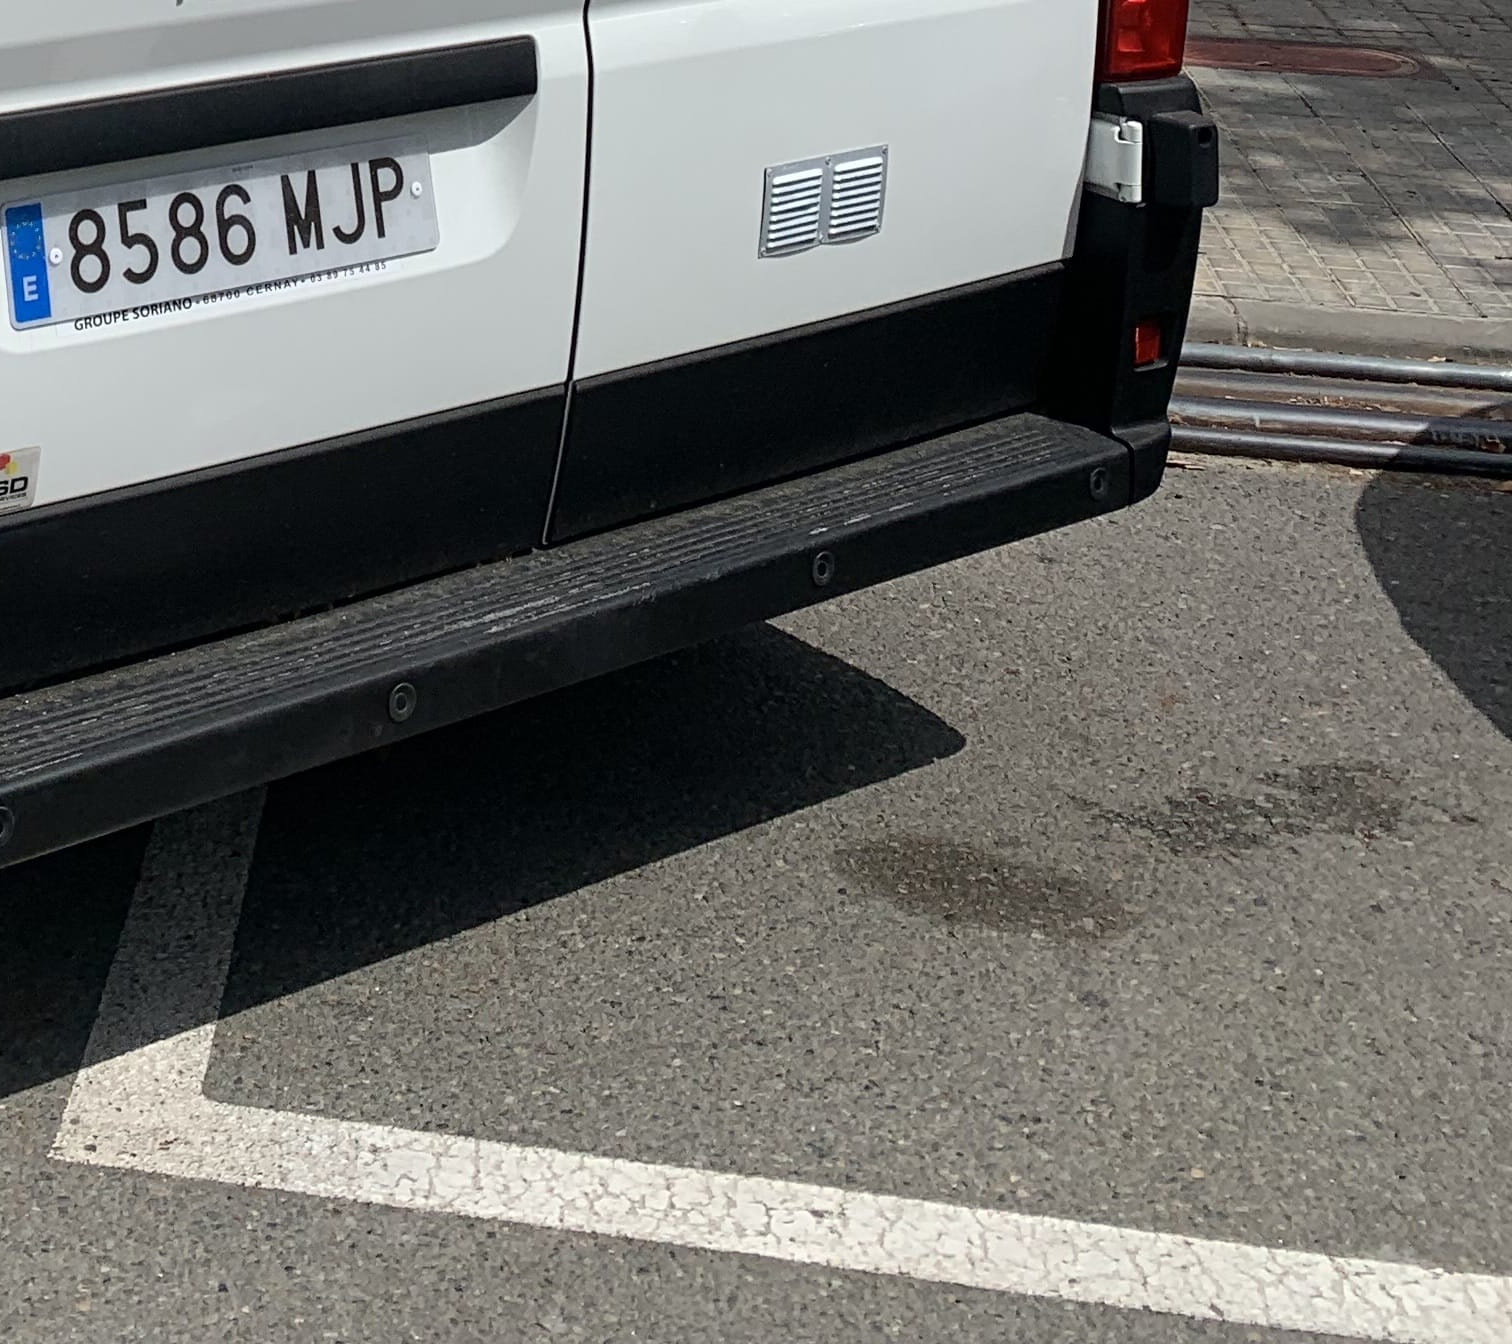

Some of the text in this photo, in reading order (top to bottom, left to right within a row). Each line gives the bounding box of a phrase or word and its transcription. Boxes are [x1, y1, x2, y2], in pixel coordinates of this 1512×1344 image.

[68, 156, 405, 293] 8586 MJP
[22, 274, 40, 302] E
[74, 309, 129, 331] GROUPE
[132, 297, 192, 320] SORIANO
[246, 277, 299, 296] CERNAY
